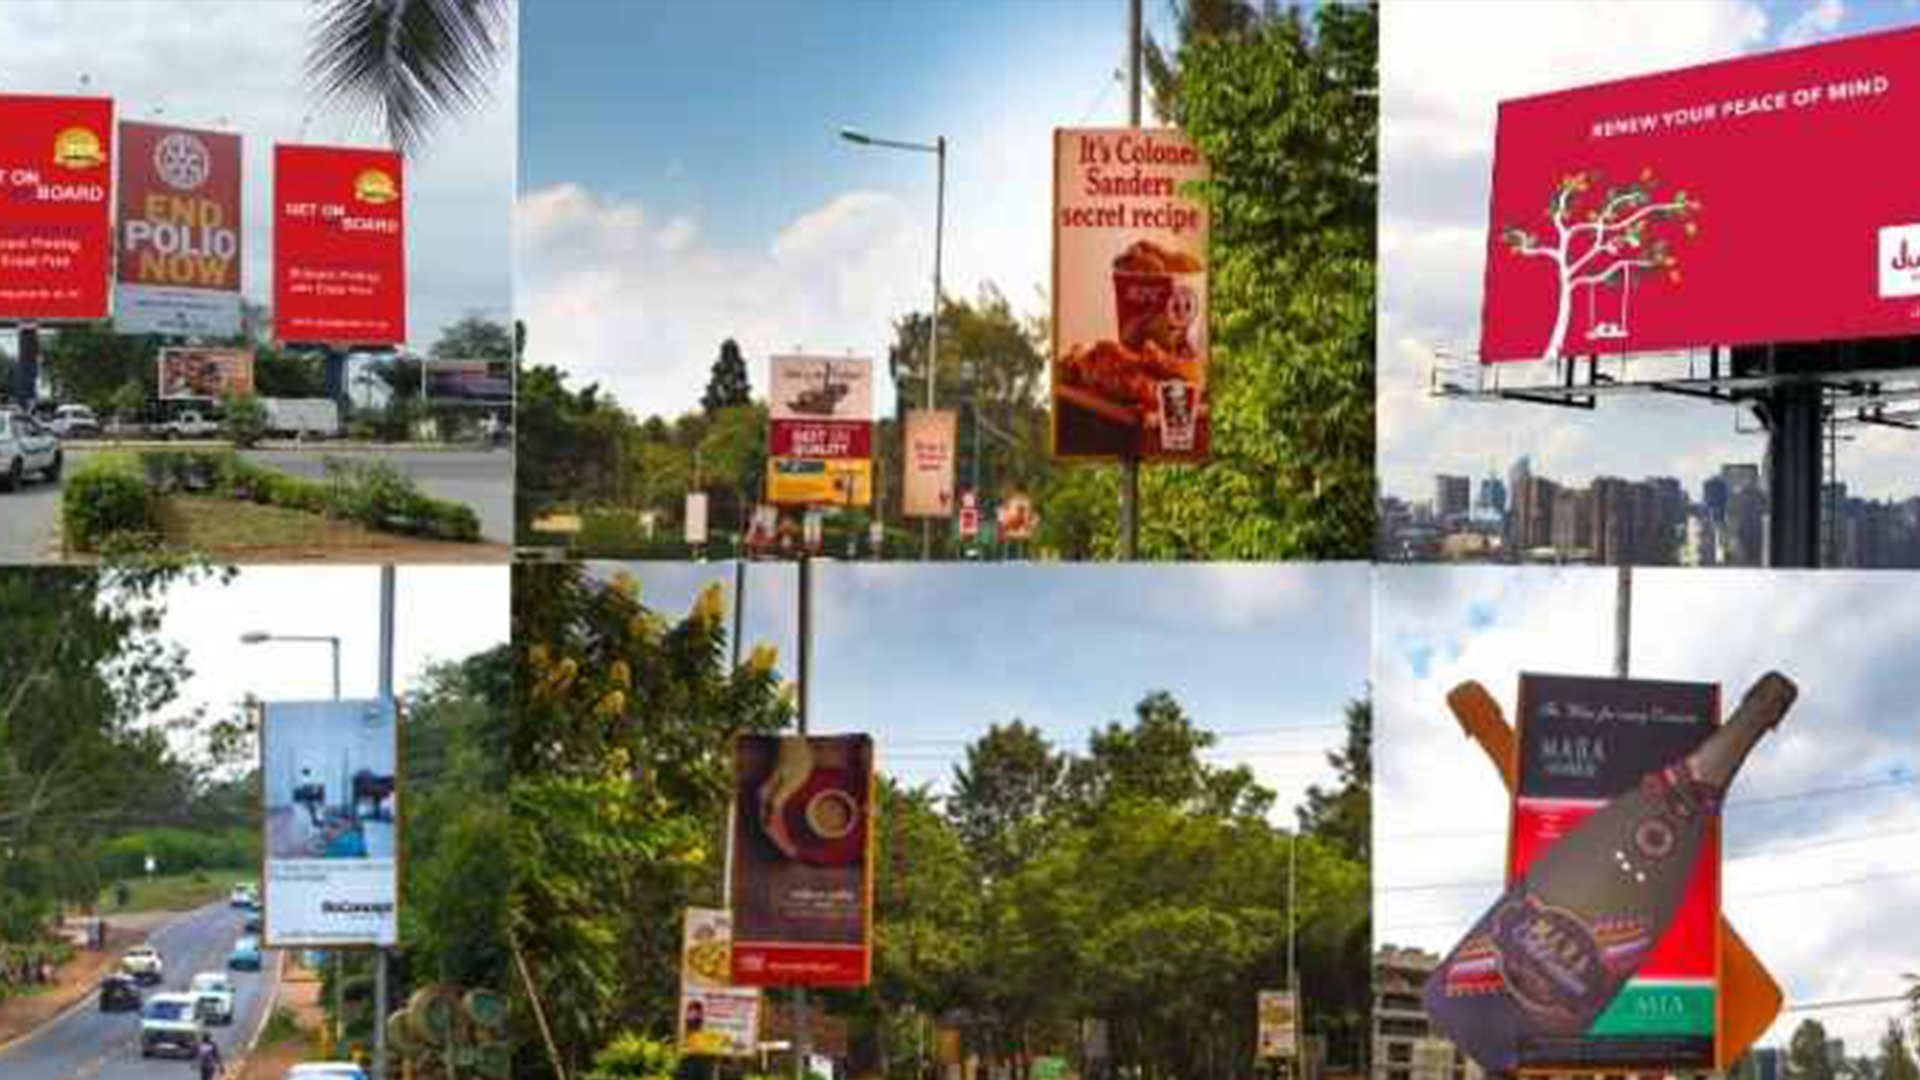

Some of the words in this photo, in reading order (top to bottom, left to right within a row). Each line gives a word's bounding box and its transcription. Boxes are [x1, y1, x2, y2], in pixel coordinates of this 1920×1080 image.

[1593, 113, 1659, 137] RENEW
[1662, 104, 1716, 128] YOUR
[1721, 93, 1785, 118] PEACE
[1793, 86, 1822, 107] OF
[1827, 75, 1889, 101] MIND
[1079, 134, 1110, 164] It's
[37, 184, 104, 202] BOARD
[144, 194, 222, 227] END
[1062, 203, 1125, 227] secret
[1132, 205, 1198, 233] recipe
[124, 220, 236, 259] POLIO
[140, 250, 229, 284] NOW
